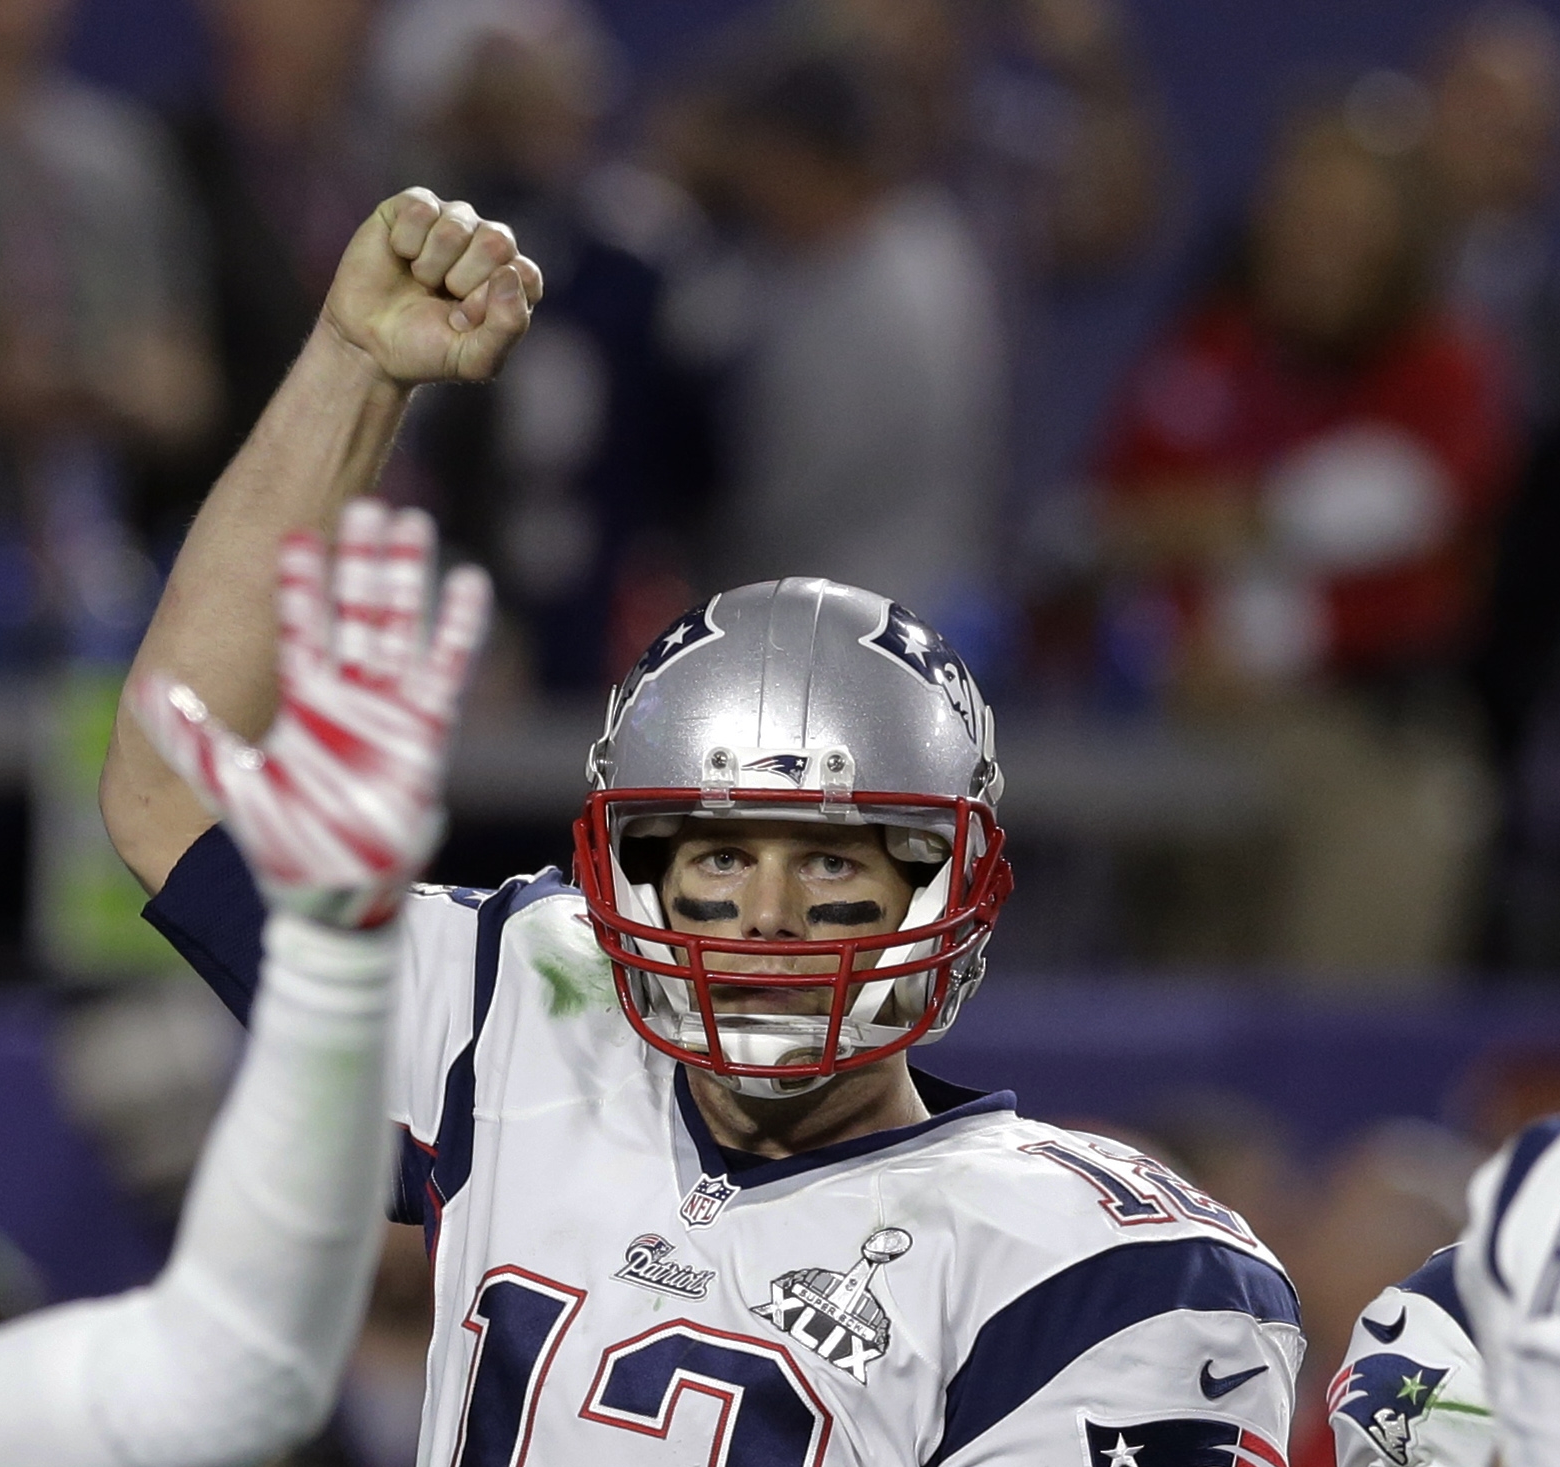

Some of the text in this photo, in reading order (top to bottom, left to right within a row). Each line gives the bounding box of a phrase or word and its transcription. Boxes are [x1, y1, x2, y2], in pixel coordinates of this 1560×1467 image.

[683, 1193, 716, 1221] NFL
[614, 1247, 716, 1299] Patriots
[749, 1282, 885, 1386] XLIX
[799, 1288, 867, 1339] SUPER BOWL
